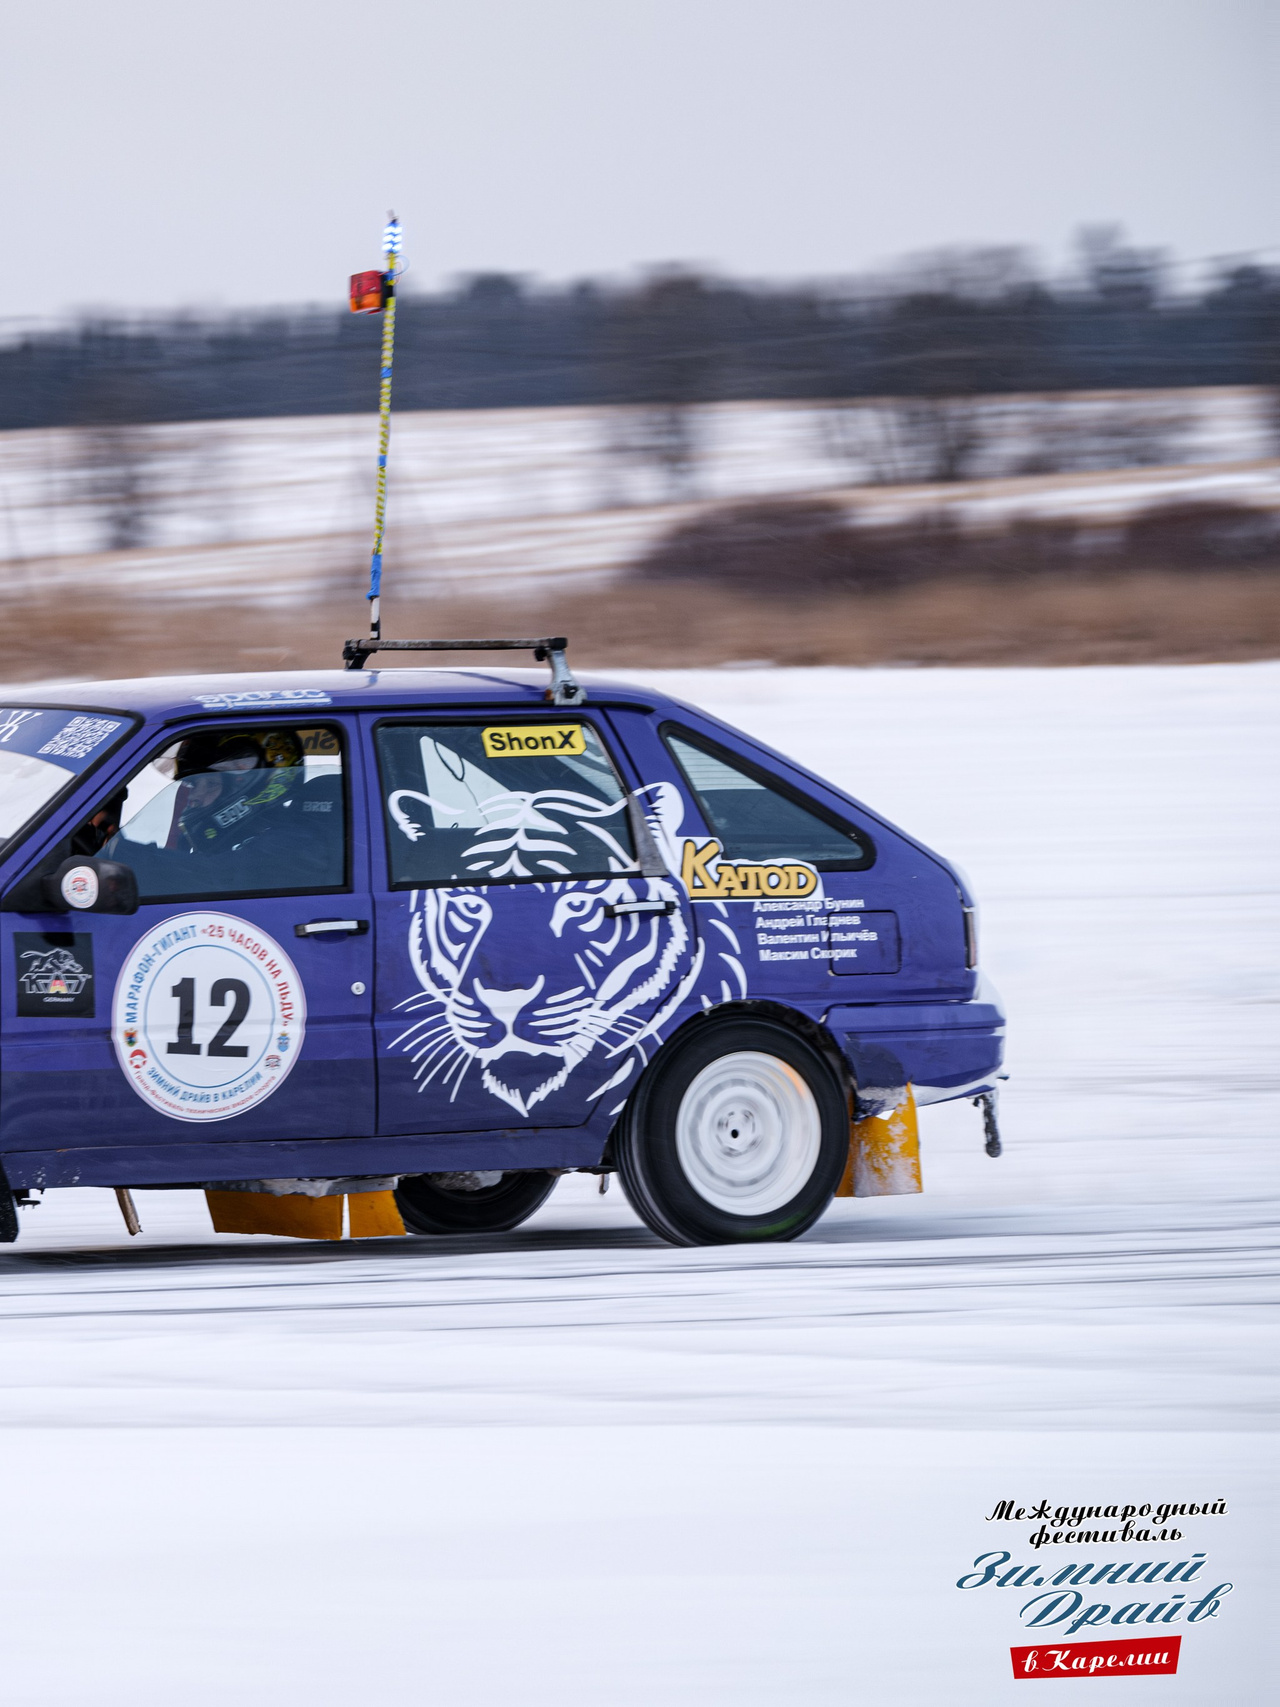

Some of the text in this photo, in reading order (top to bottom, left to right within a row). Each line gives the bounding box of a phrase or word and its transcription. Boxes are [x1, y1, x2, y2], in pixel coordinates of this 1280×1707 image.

[489, 729, 576, 751] ShonX
[752, 897, 865, 912] Александр Бунин
[755, 914, 862, 930] Андрей Гладнев
[757, 932, 819, 945] Валентин
[759, 947, 858, 961] Максим Скорик
[125, 925, 197, 1023] МАРАФОН-ГИГАНТ
[228, 928, 270, 961] ЧАСОВ
[264, 959, 282, 980] НА
[166, 977, 252, 1058] 12
[146, 1067, 263, 1104] ЗИМНИЙ ДРАЙВ В КАРЕЛИИ
